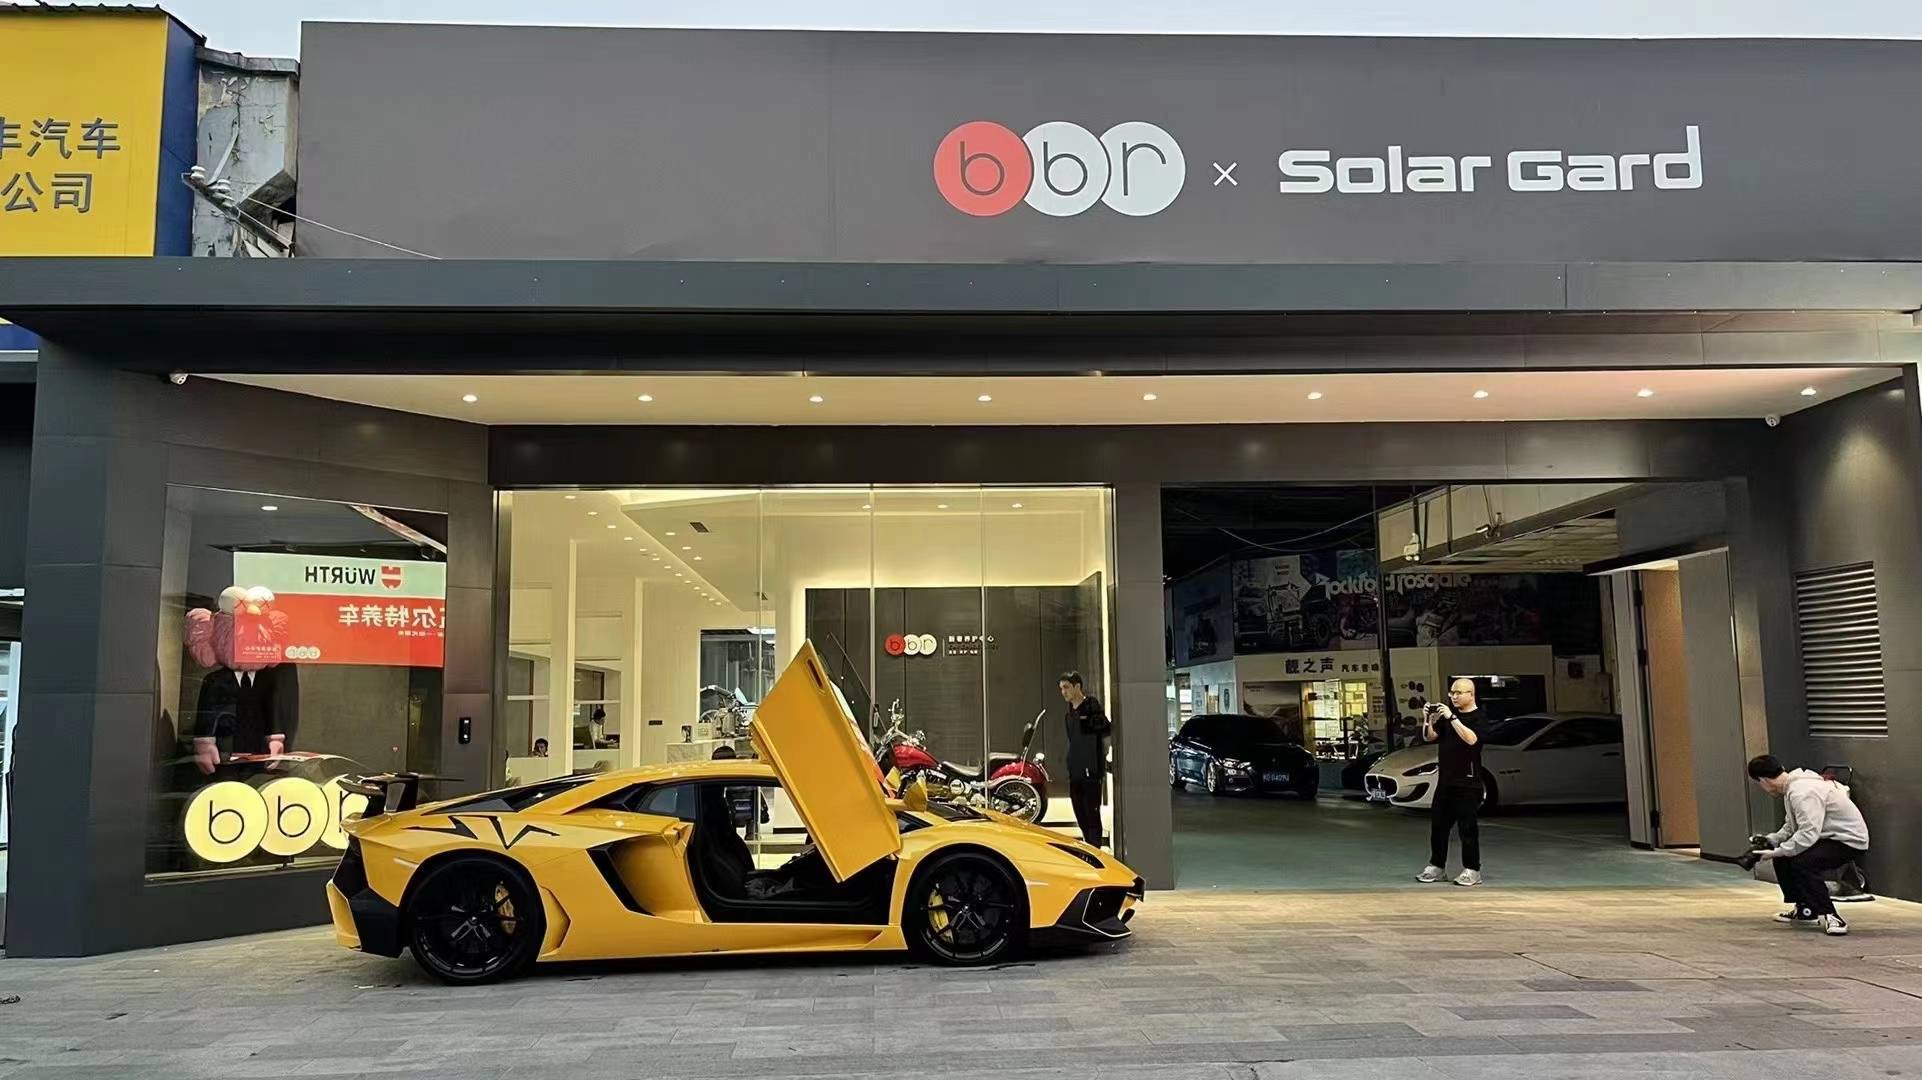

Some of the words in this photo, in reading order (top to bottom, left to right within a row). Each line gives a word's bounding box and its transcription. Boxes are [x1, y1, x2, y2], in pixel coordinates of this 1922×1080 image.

[954, 138, 1170, 199] bbr
[1278, 144, 1492, 194] Solar
[1506, 124, 1704, 191] Gard
[1, 171, 94, 213] 公司
